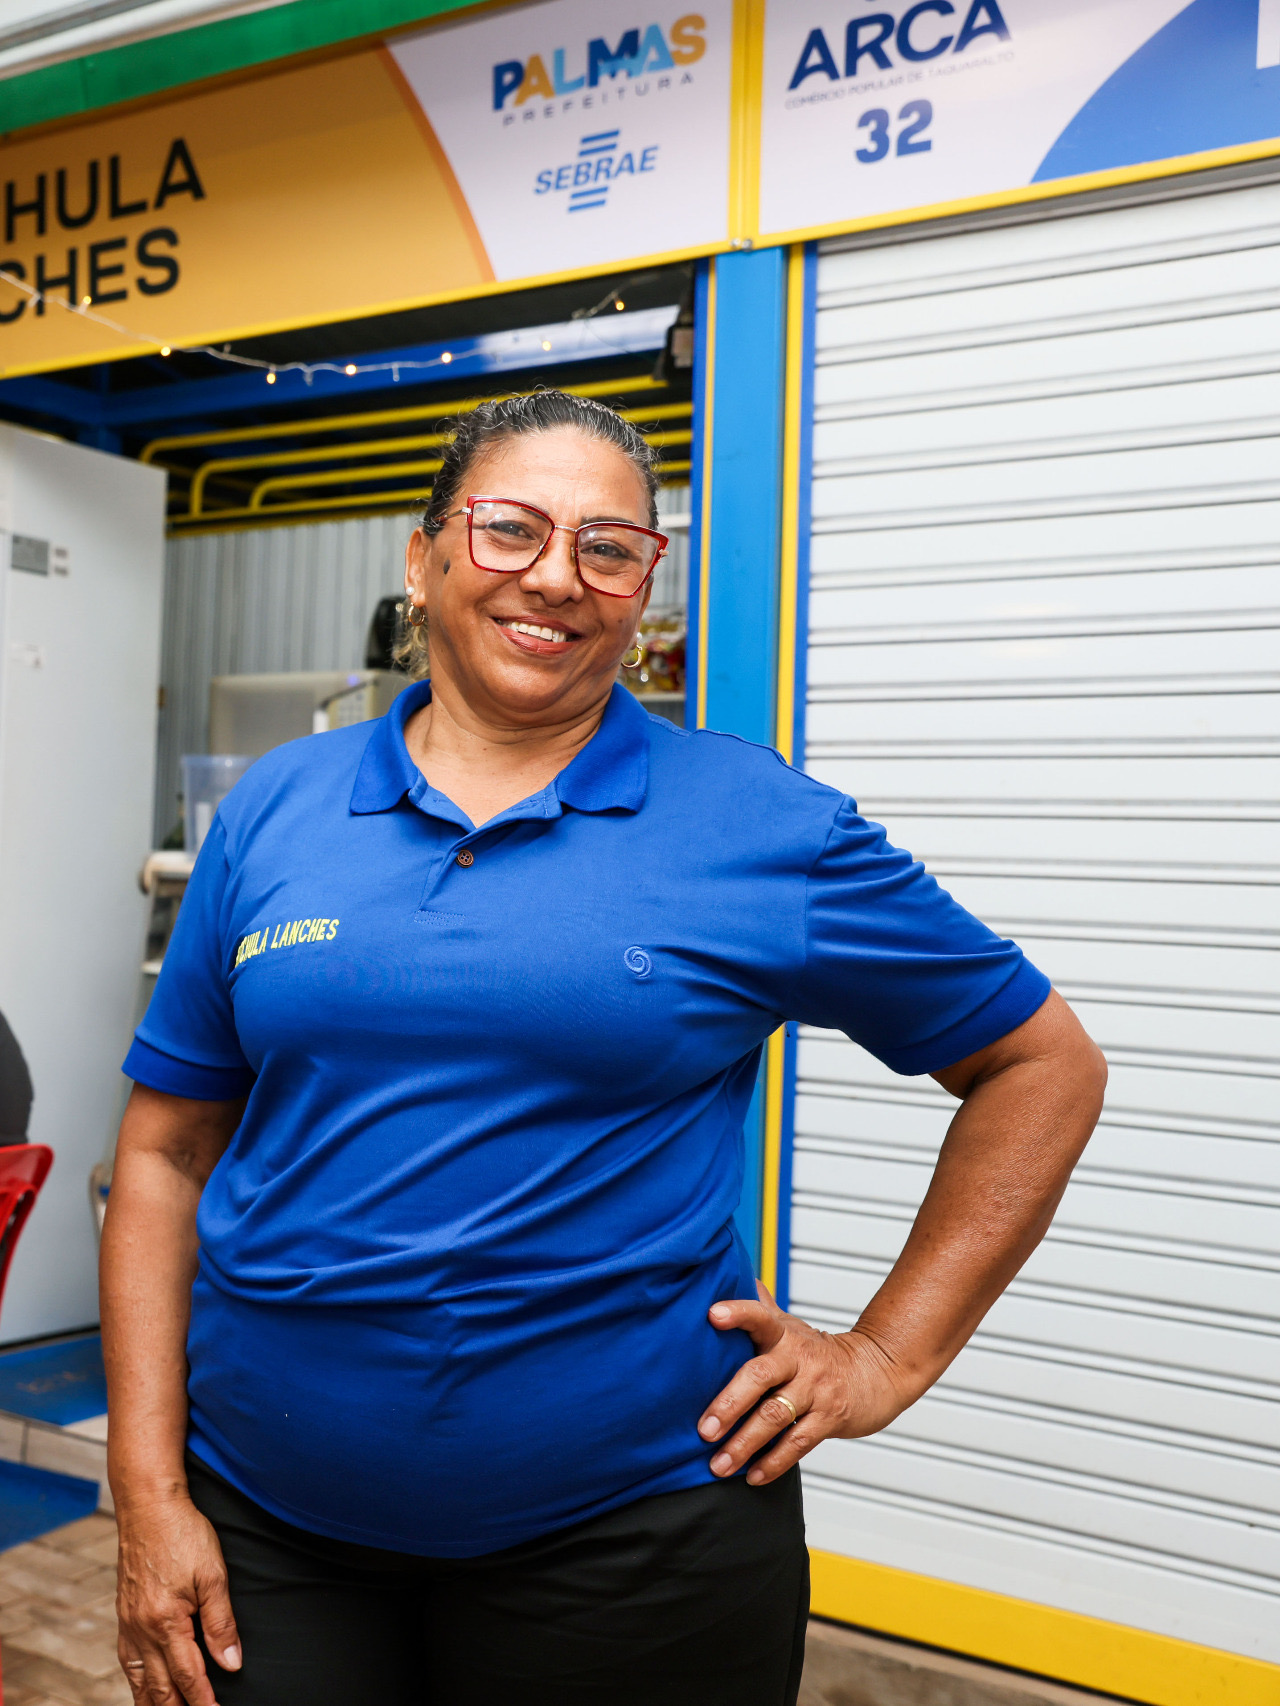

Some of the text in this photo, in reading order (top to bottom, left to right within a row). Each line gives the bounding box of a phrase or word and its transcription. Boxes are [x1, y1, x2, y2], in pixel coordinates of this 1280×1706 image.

[492, 13, 707, 112] PALMAS
[787, 0, 1012, 91] ARCA
[502, 72, 695, 127] PREFEITURA
[855, 99, 933, 164] 32
[534, 145, 659, 195] SEBRAE
[271, 918, 340, 949] LANCHES
